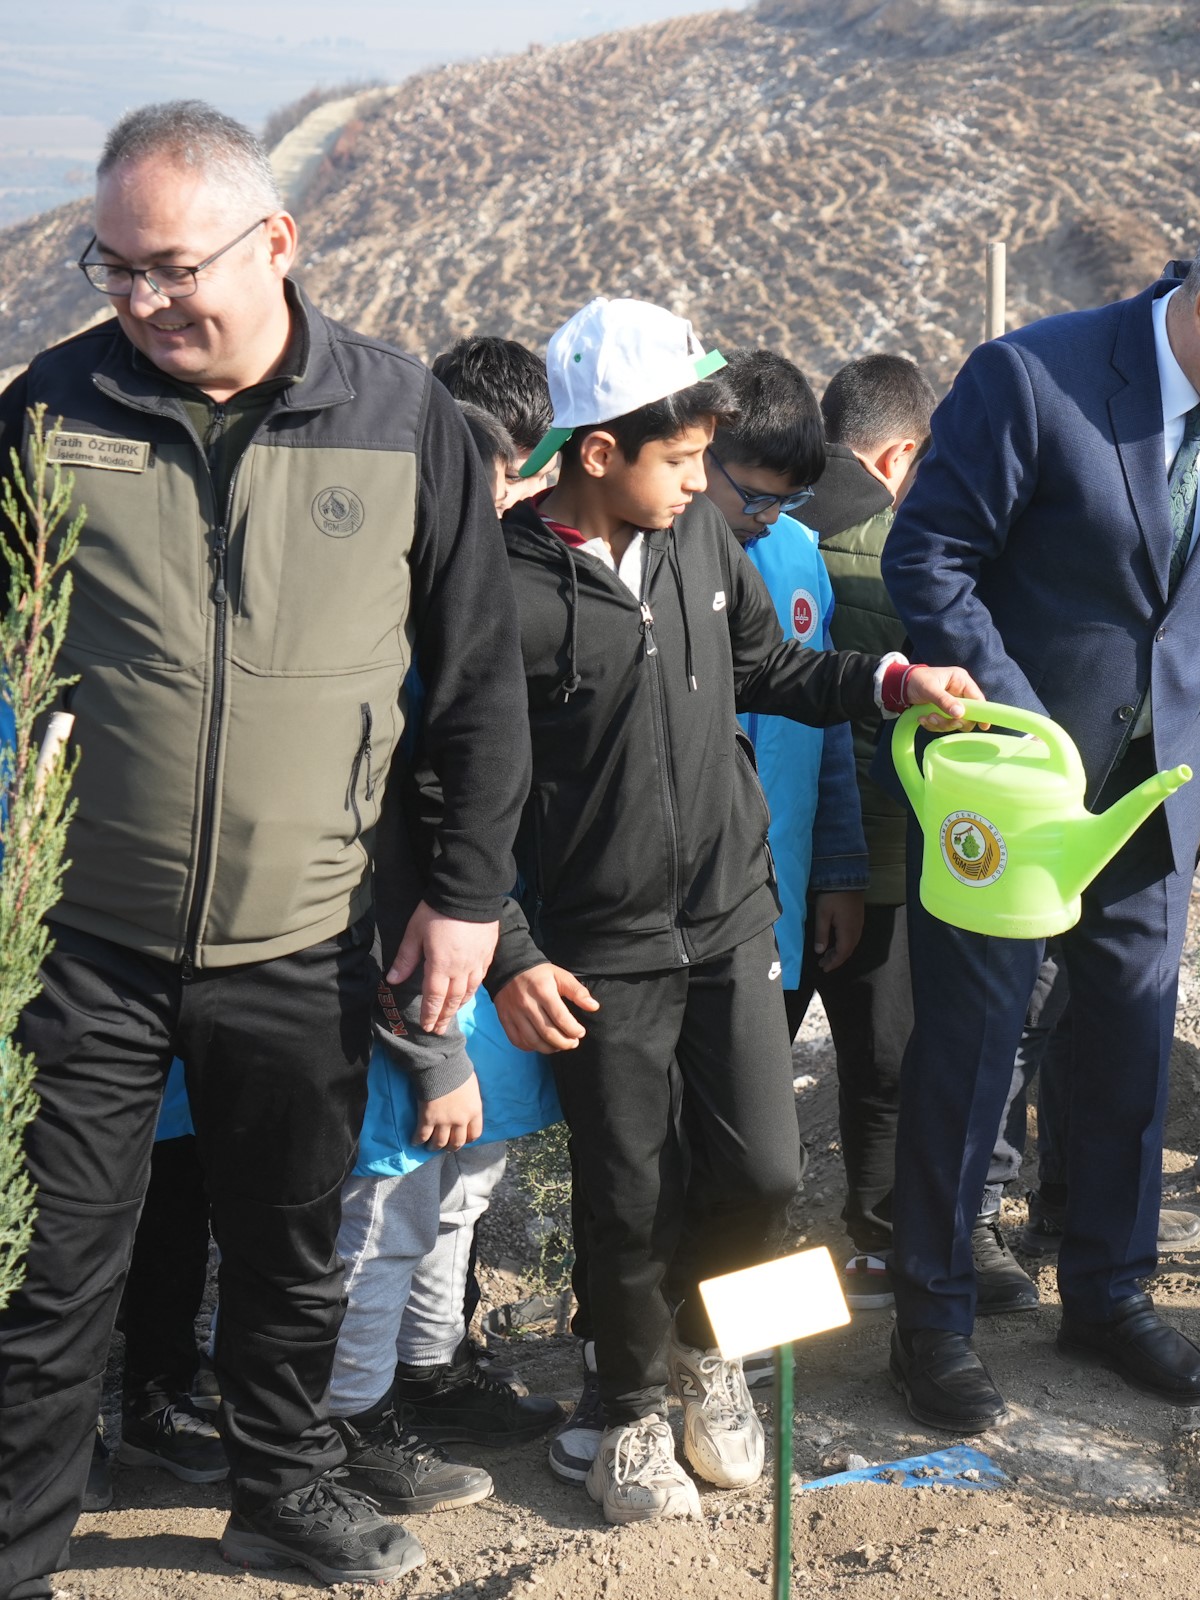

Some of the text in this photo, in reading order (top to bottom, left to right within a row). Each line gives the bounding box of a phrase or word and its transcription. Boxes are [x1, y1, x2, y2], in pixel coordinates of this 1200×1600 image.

[54, 436, 139, 455] Fatih ÖZTÜRK
[99, 455, 134, 466] Müdürü
[955, 812, 983, 822] GENEL
[953, 852, 967, 871] OGM
